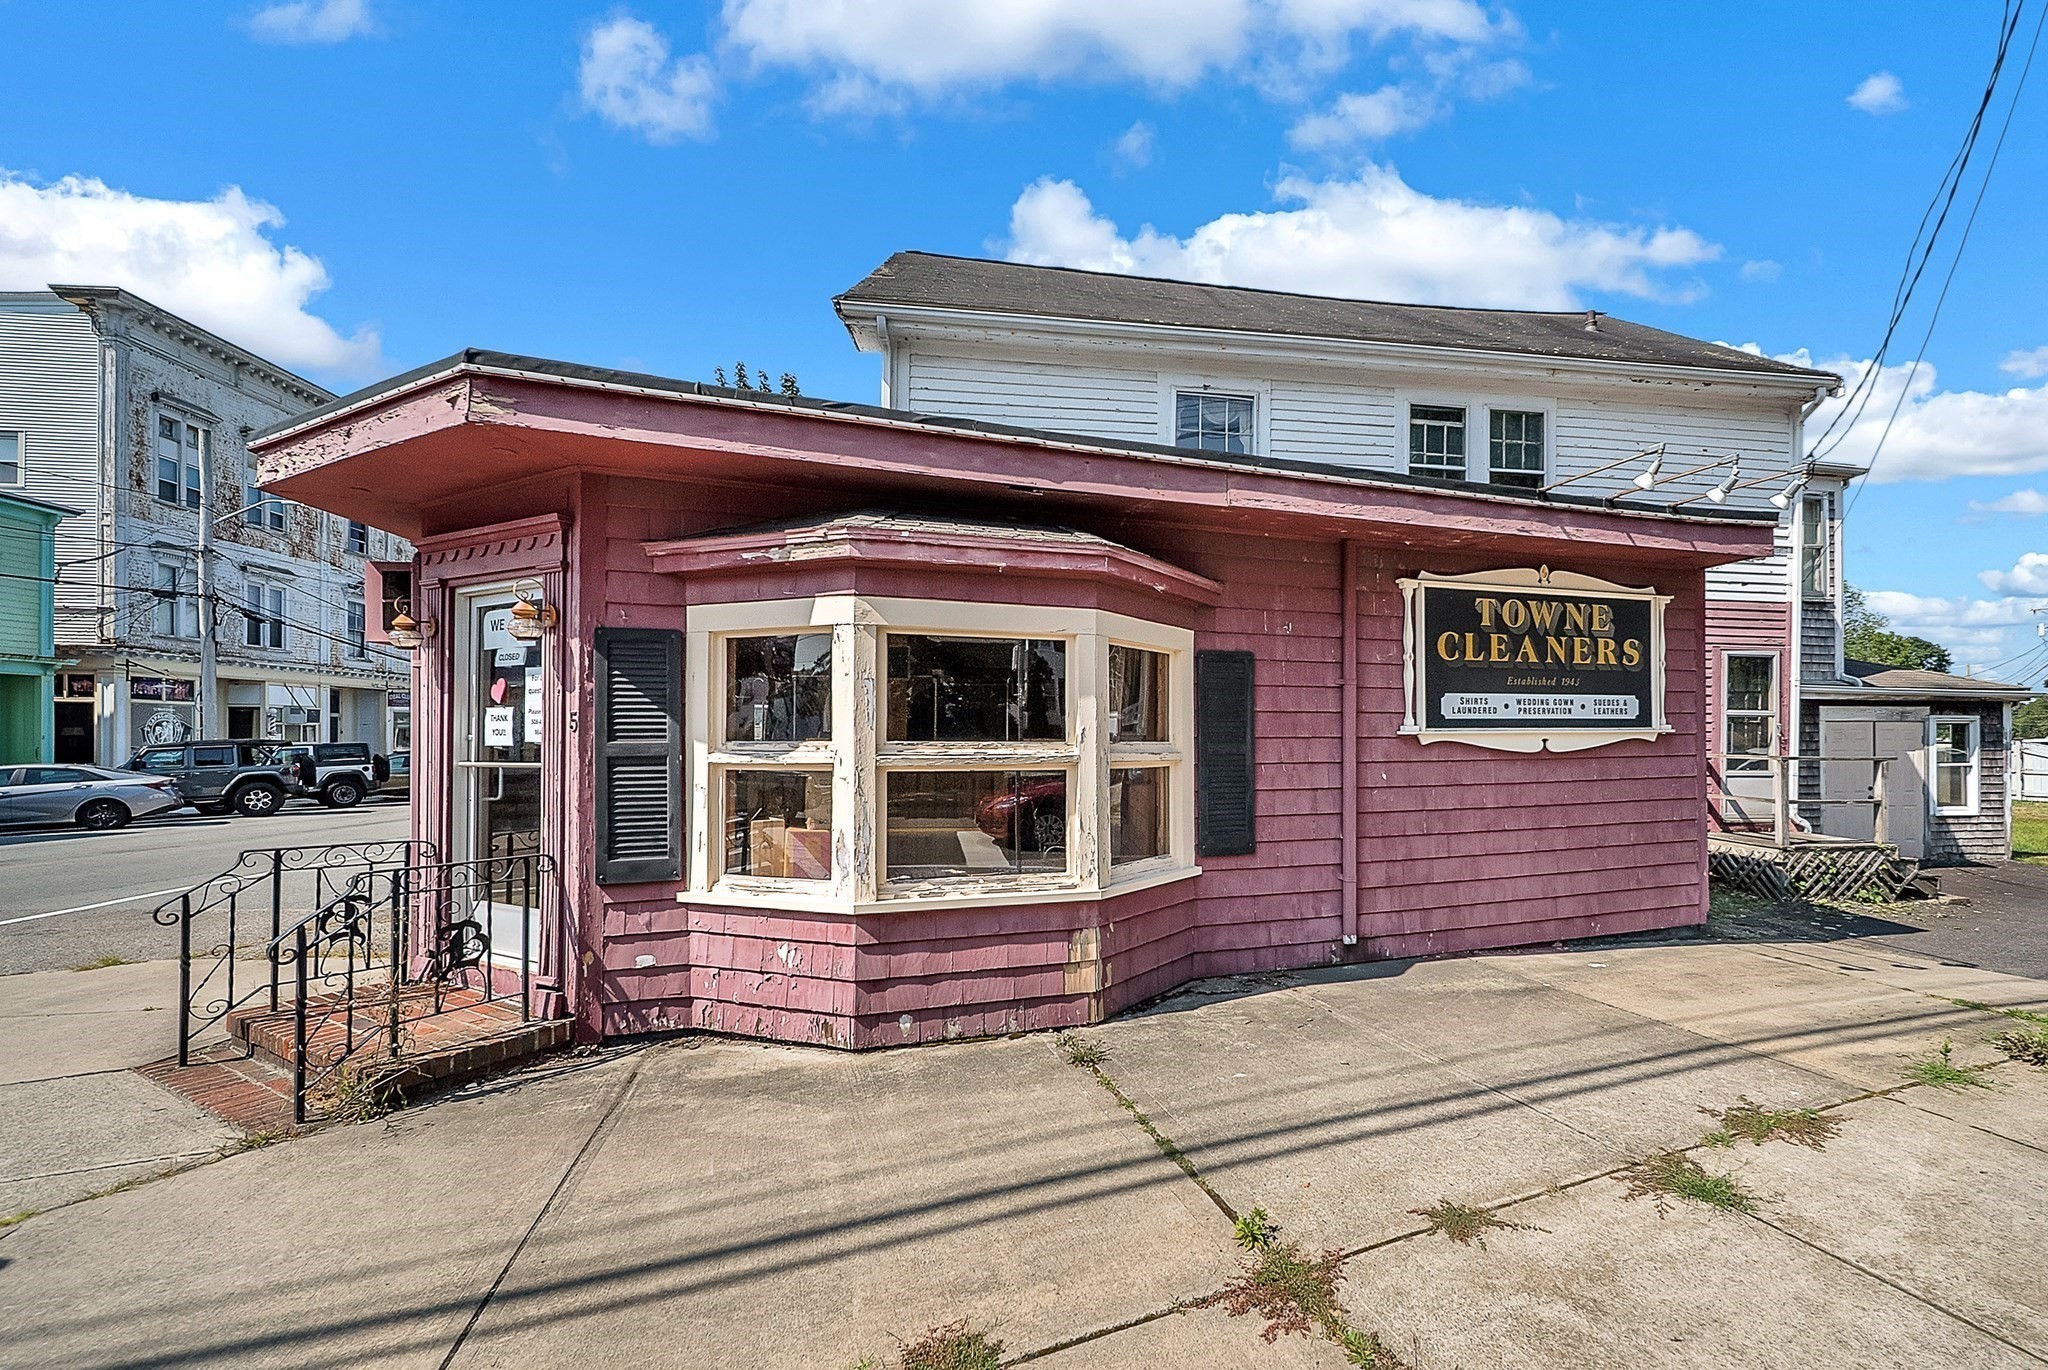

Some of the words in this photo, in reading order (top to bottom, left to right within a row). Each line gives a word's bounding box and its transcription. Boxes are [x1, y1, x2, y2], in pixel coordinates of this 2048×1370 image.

[1475, 597, 1613, 632] TOWNE
[490, 618, 506, 632] WE
[1437, 631, 1641, 666] CLEANERS
[498, 652, 520, 661] CLOSED
[1506, 676, 1557, 687] Established
[1459, 696, 1489, 706] SHIRTS
[1515, 698, 1550, 706] WEDDING
[1552, 698, 1575, 707] GOWN
[1593, 699, 1620, 707] SUEDES
[1622, 699, 1628, 707] &
[1451, 706, 1498, 715] LAUNDERED
[1517, 706, 1573, 715] PRESERVATION
[1593, 707, 1629, 716] LEATHERS
[490, 714, 509, 722] THANK
[570, 711, 578, 734] 5
